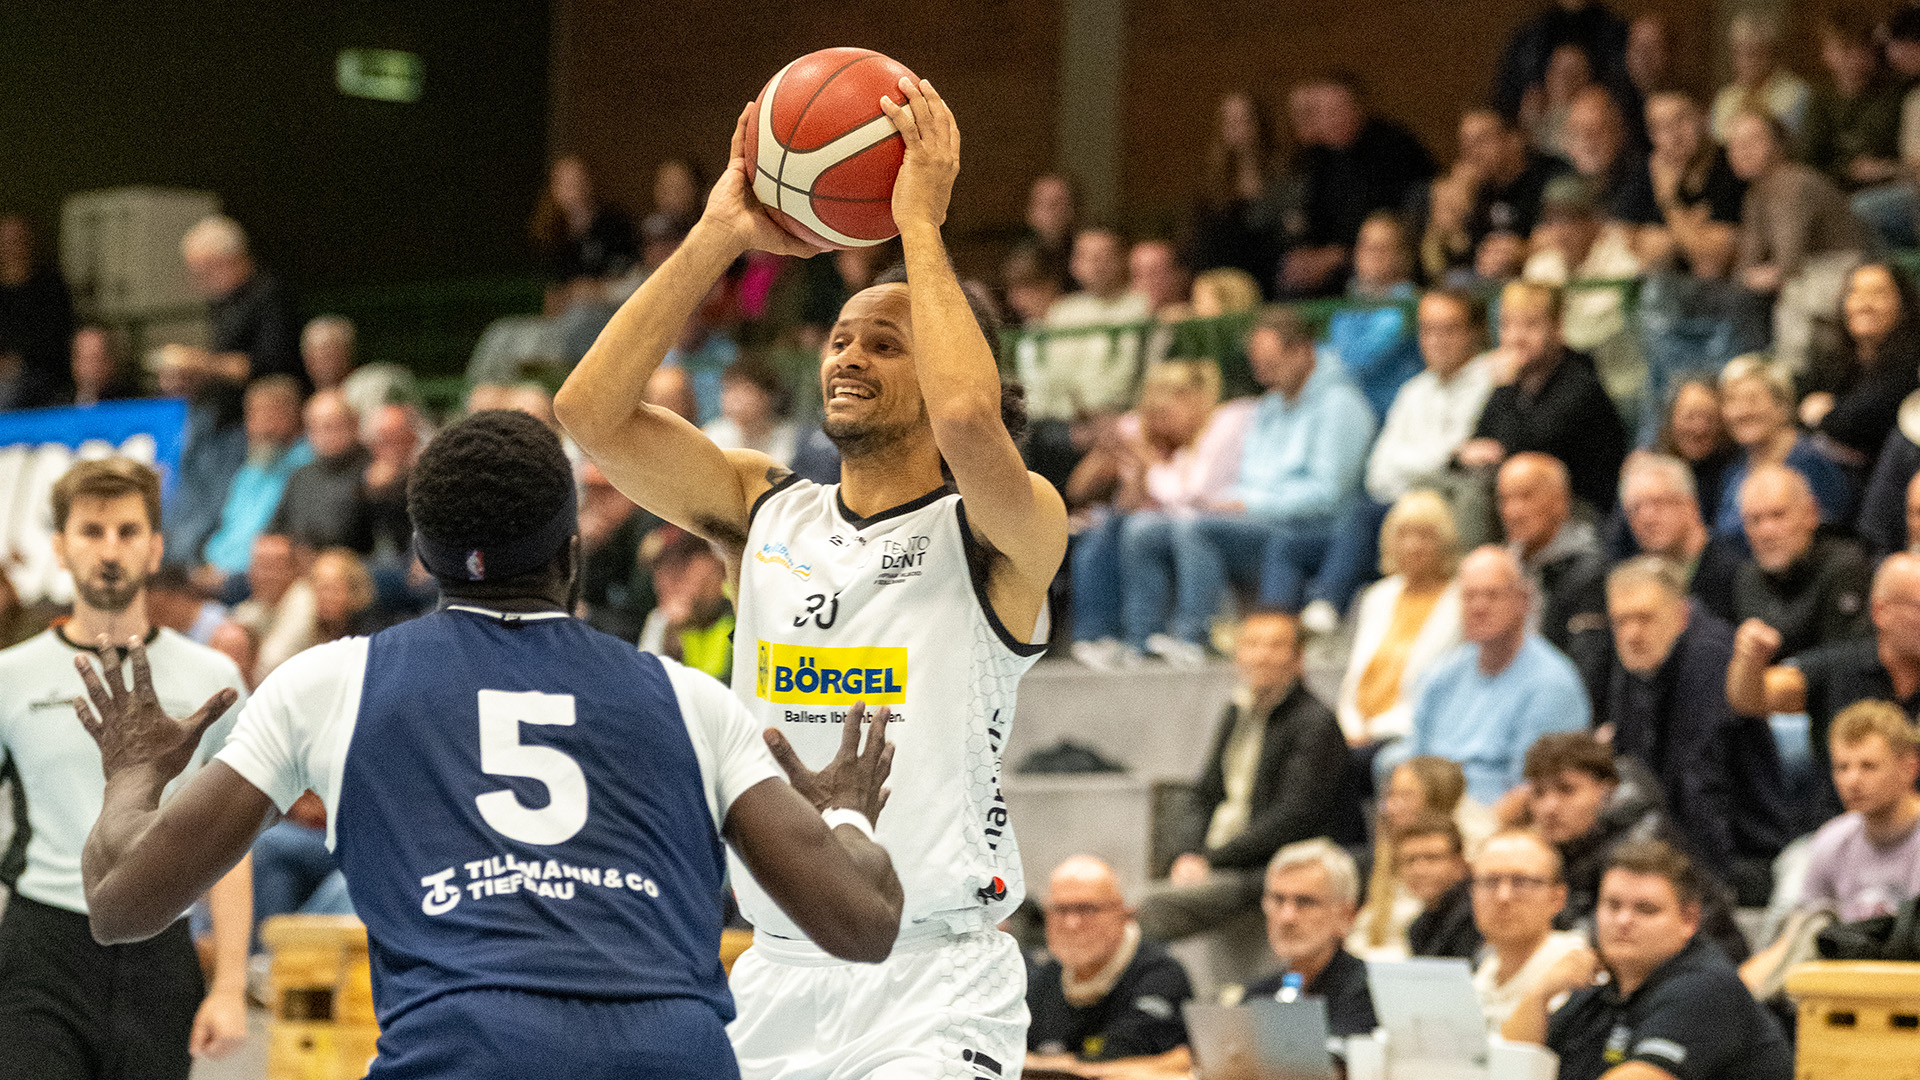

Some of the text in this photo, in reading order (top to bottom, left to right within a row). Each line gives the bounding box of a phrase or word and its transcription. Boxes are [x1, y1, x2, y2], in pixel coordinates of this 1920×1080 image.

[774, 656, 902, 694] BÖRGEL
[784, 710, 827, 724] Ballers
[475, 688, 589, 846] 5
